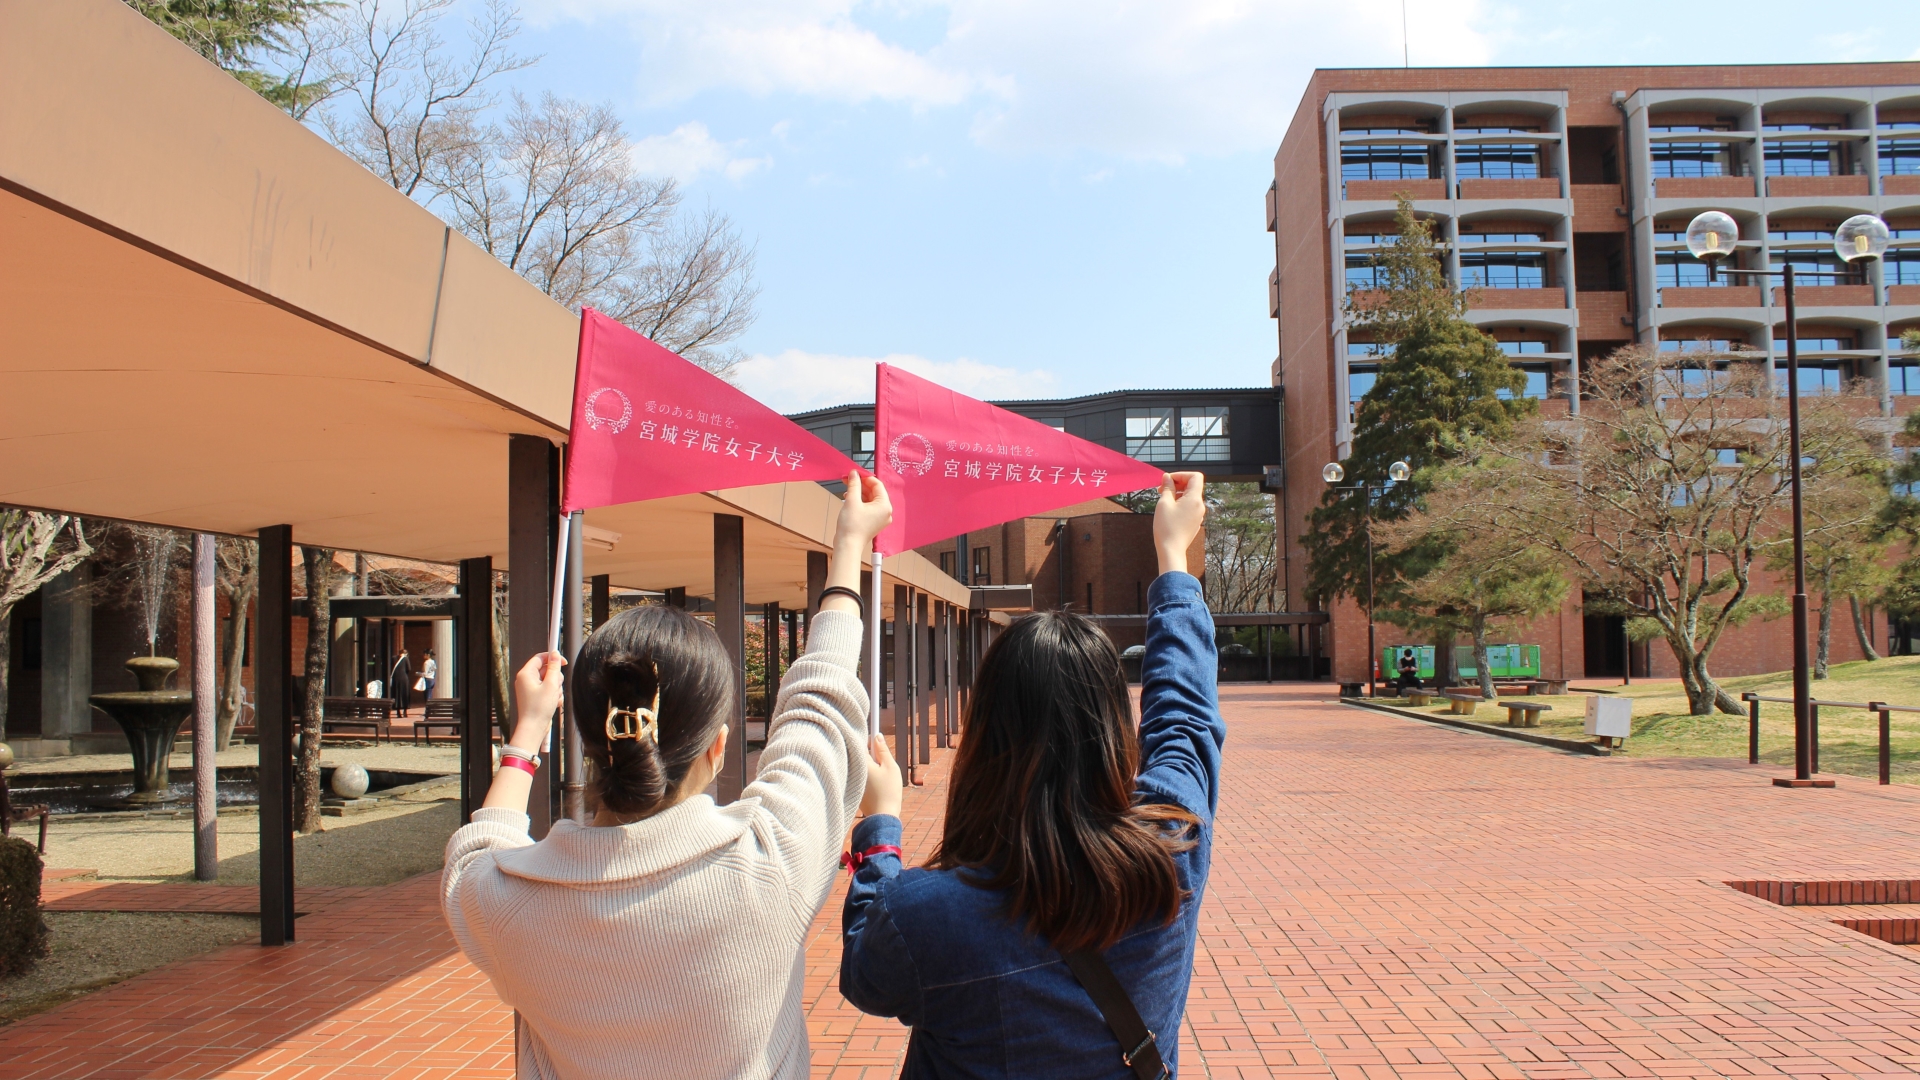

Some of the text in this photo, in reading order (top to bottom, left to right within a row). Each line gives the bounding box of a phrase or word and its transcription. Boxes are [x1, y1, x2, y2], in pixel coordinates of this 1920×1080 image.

[644, 400, 739, 430] 愛のある知性を。
[639, 420, 804, 471] 宮城学院女子大学
[945, 441, 1040, 457] 愛のある知性を。
[943, 459, 1108, 487] 宮城学院女子大学
